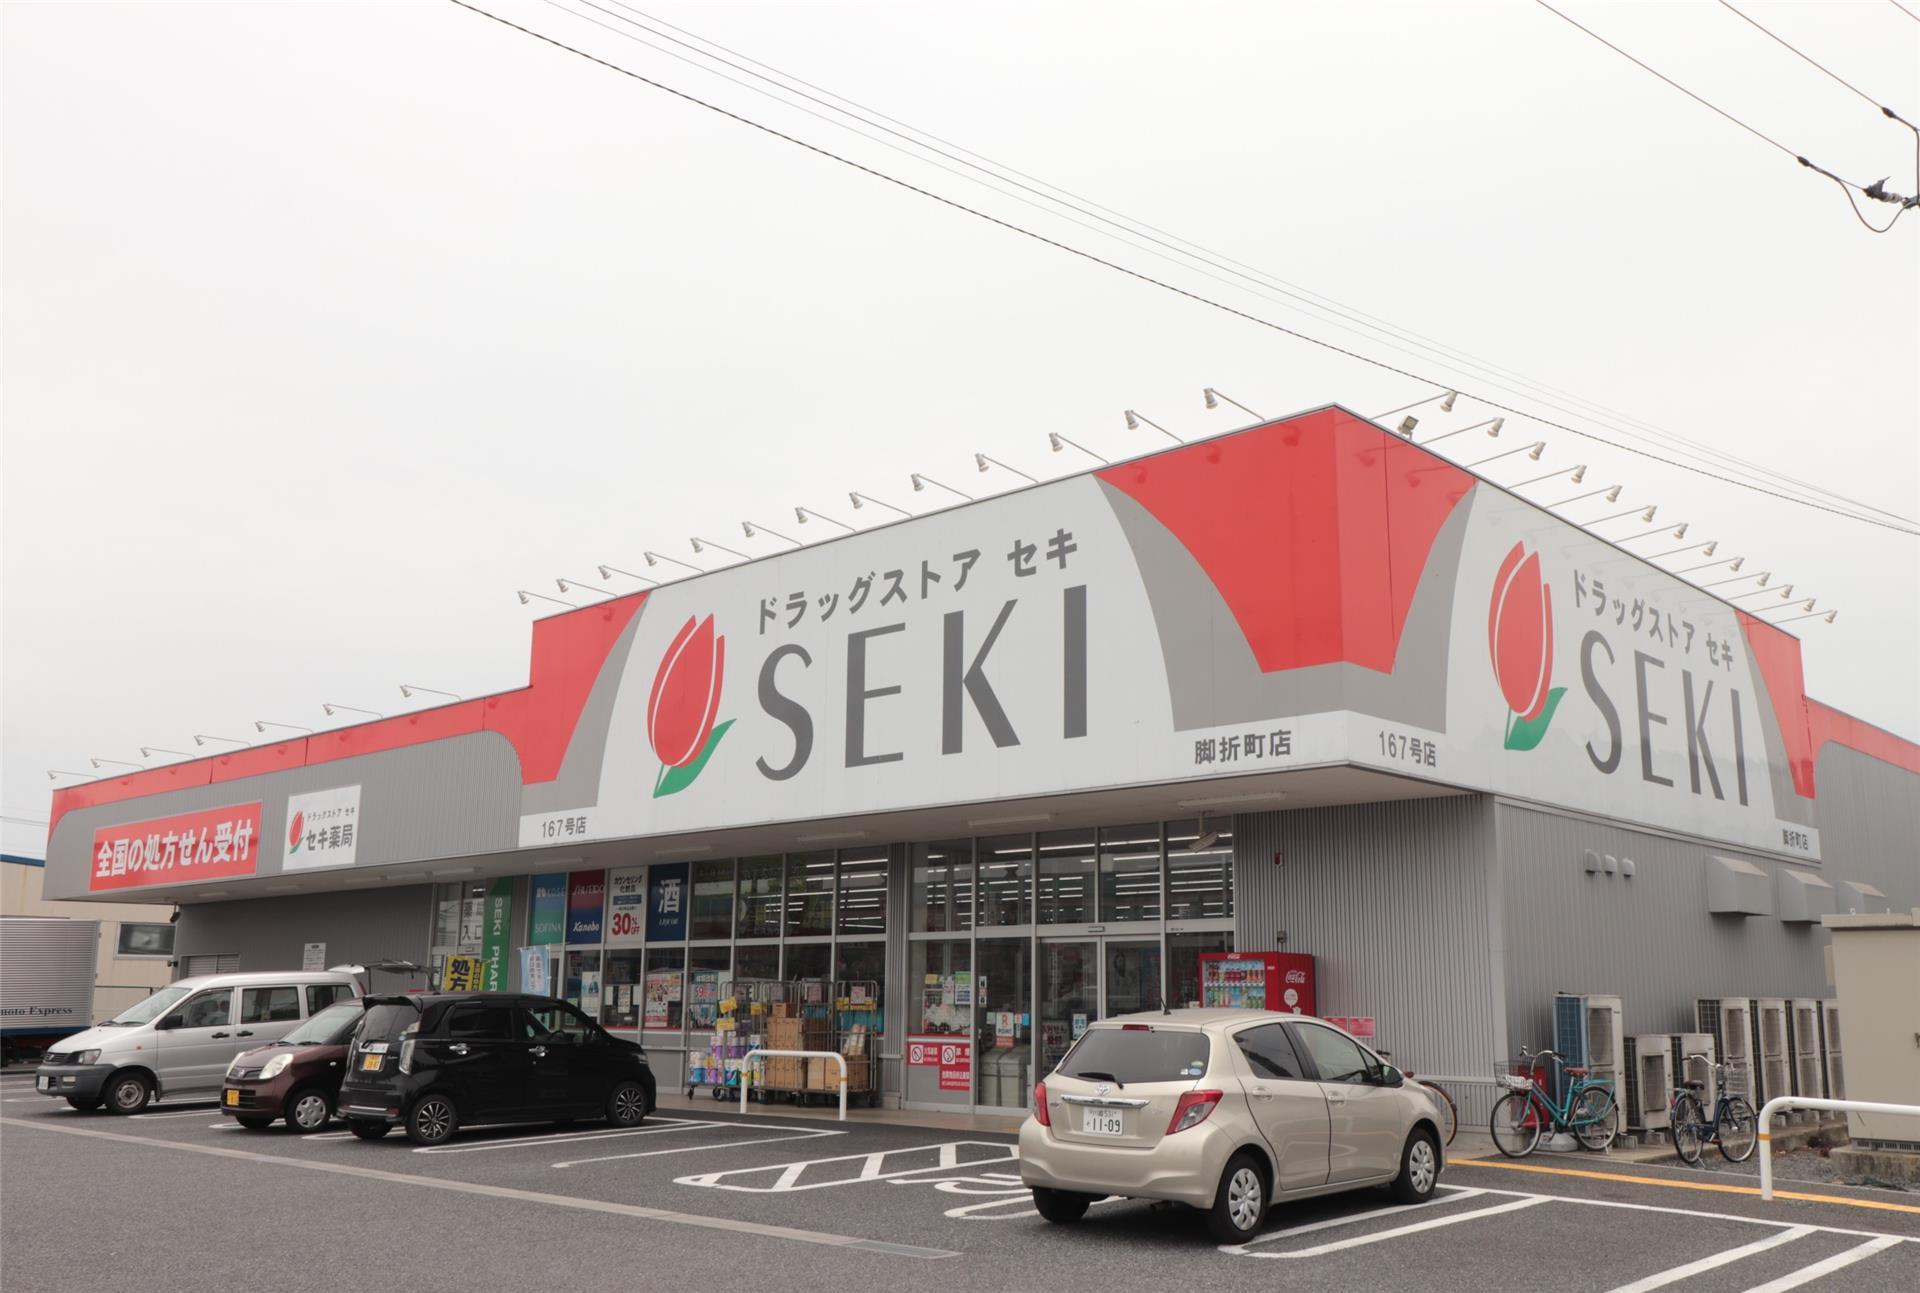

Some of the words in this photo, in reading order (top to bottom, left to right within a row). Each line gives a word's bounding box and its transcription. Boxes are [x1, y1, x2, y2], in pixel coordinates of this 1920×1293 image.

[759, 549, 981, 635] ドラッグストア
[1005, 528, 1078, 578] セキ
[1574, 569, 1695, 654] ドラッグストア
[1706, 632, 1733, 672] セキ
[755, 584, 1088, 781] SEKI
[1580, 630, 1749, 807] SEKI
[1194, 729, 1292, 765] 脚折町店
[1379, 730, 1437, 768] 167号店
[307, 809, 342, 821] ドラッグストア
[345, 806, 355, 817] セキ
[542, 816, 587, 838] 167号店
[96, 819, 253, 878] 全国の処方せん受付
[305, 823, 354, 852] セキ薬局
[658, 879, 681, 914] 酒
[492, 897, 503, 936] SEKI
[573, 919, 600, 934] Kanebo
[30, 1005, 73, 1017] Express
